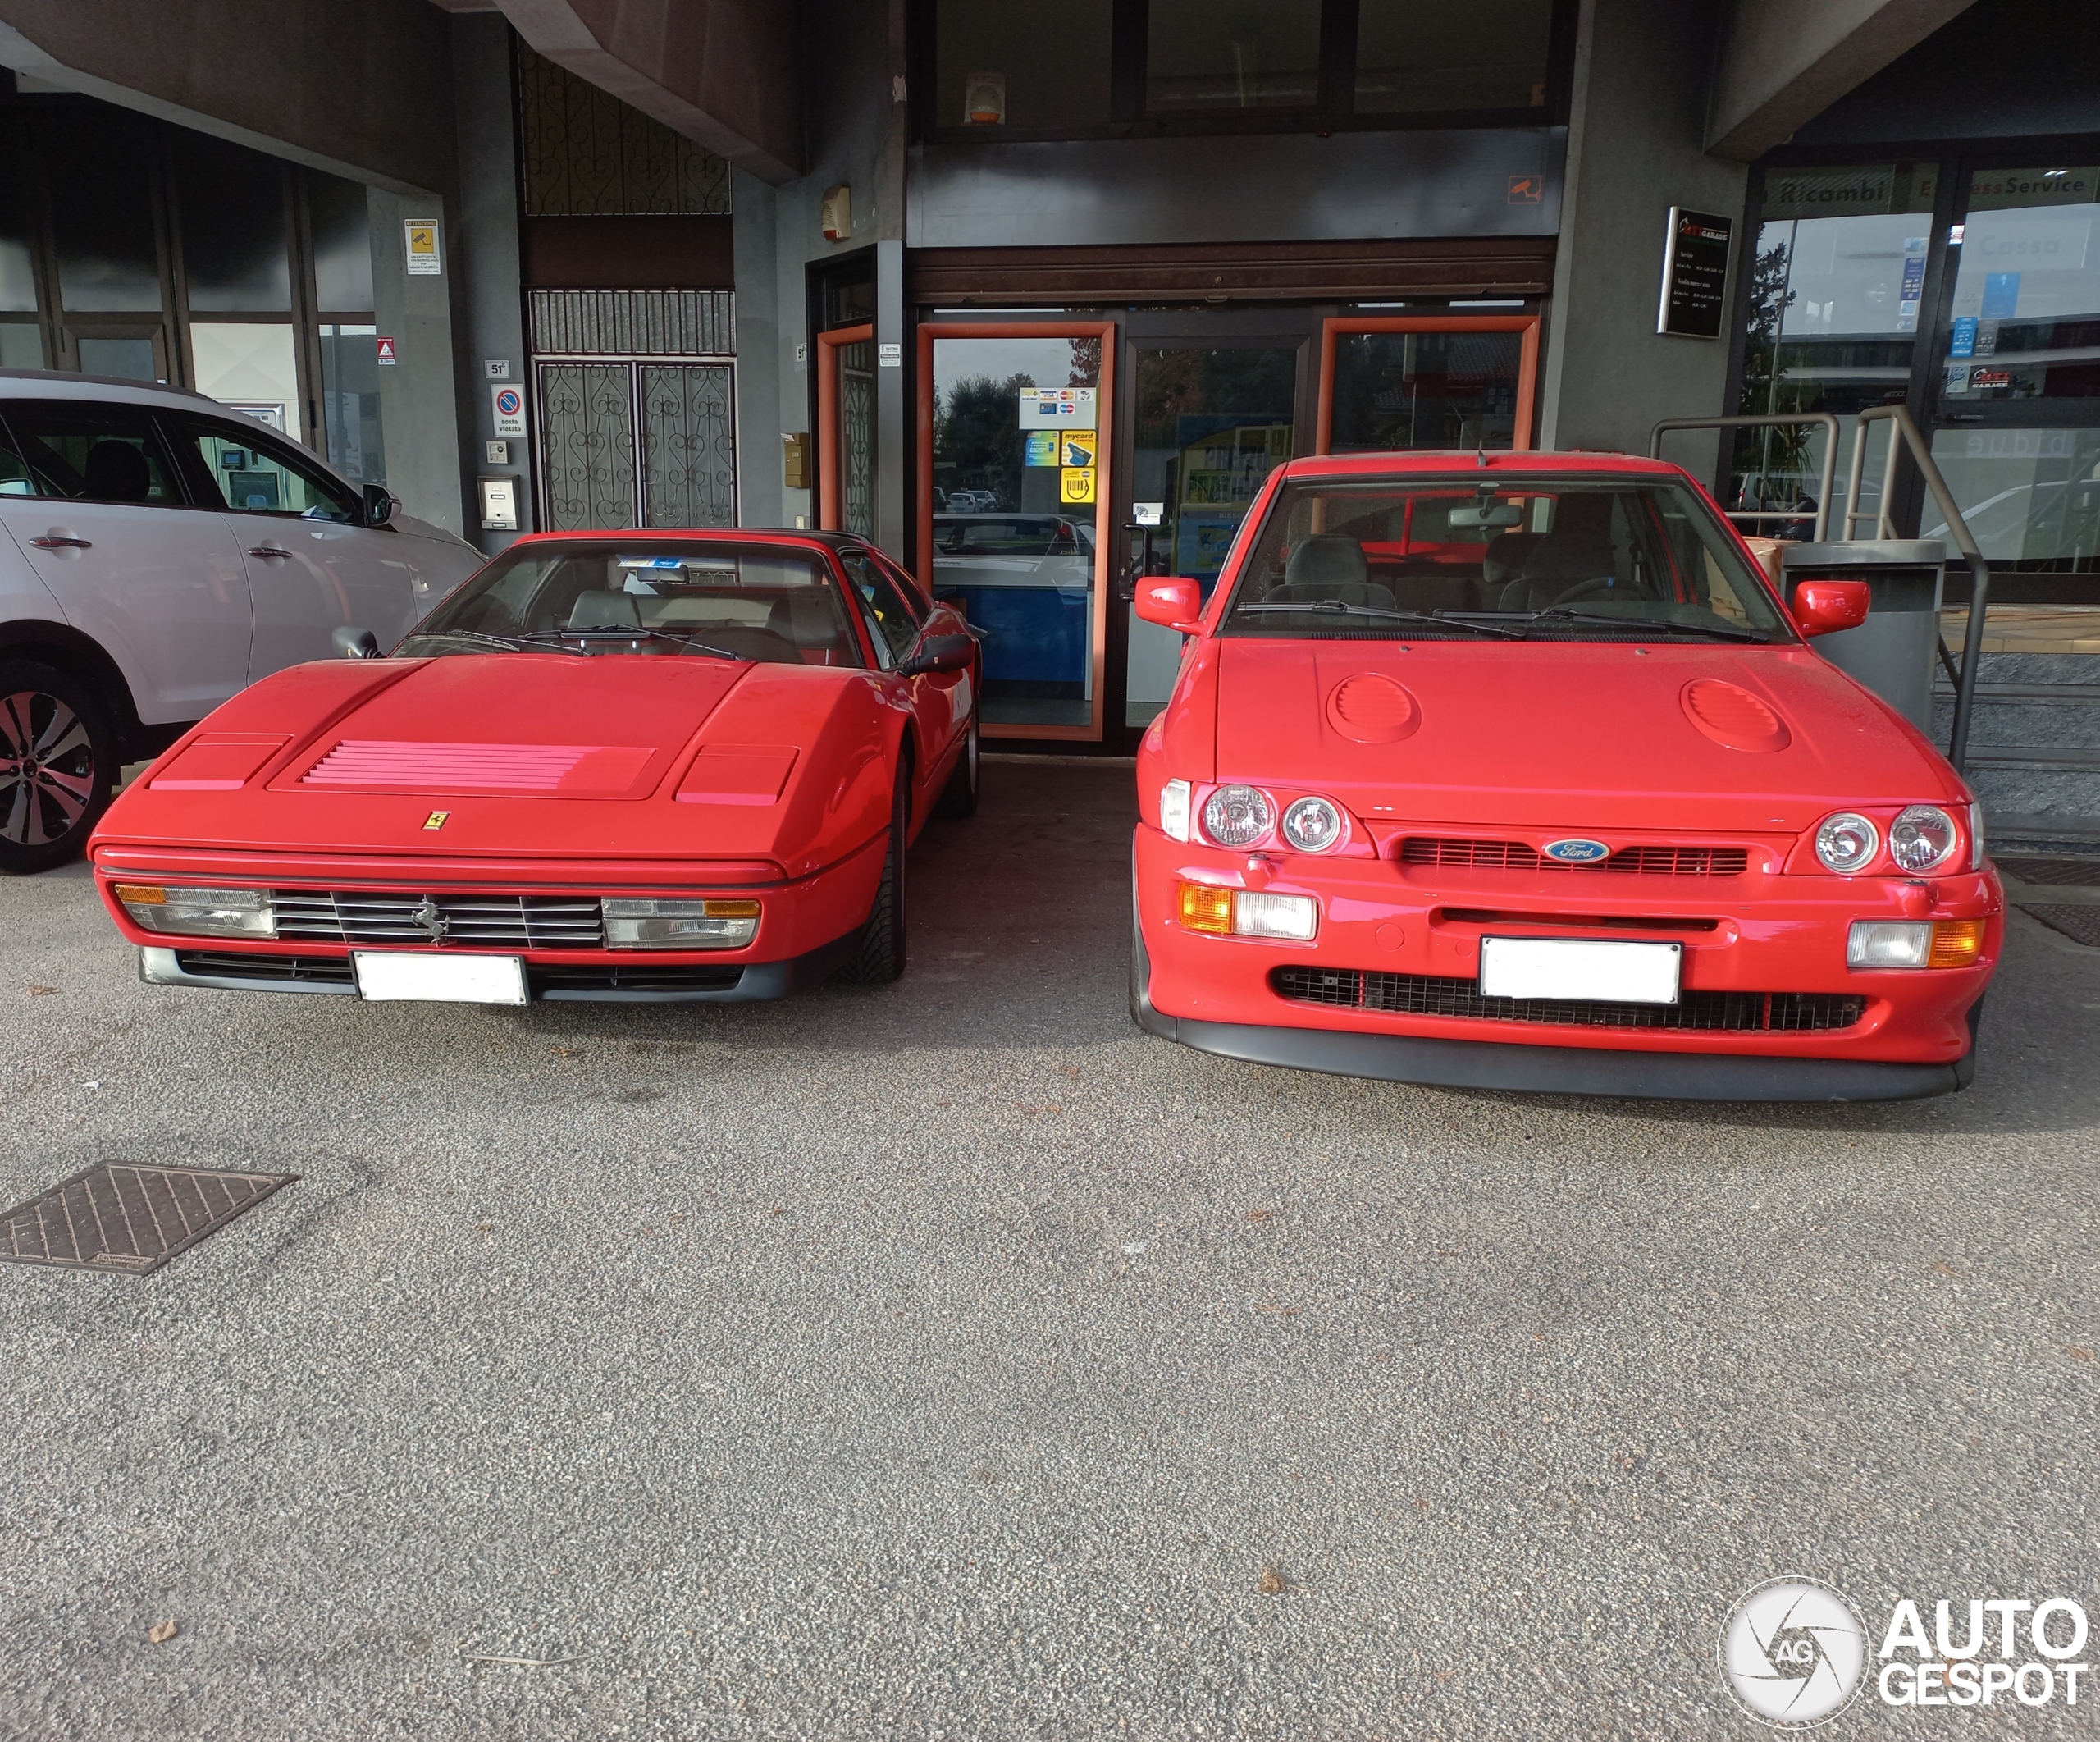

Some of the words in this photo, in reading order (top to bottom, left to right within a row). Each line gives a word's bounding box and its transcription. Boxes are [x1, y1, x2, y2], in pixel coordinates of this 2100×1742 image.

[1780, 178, 1885, 203] Ricambi
[1702, 231, 1728, 240] GARAGE
[1980, 235, 2060, 257] Cassa
[1559, 844, 1594, 857] Ford
